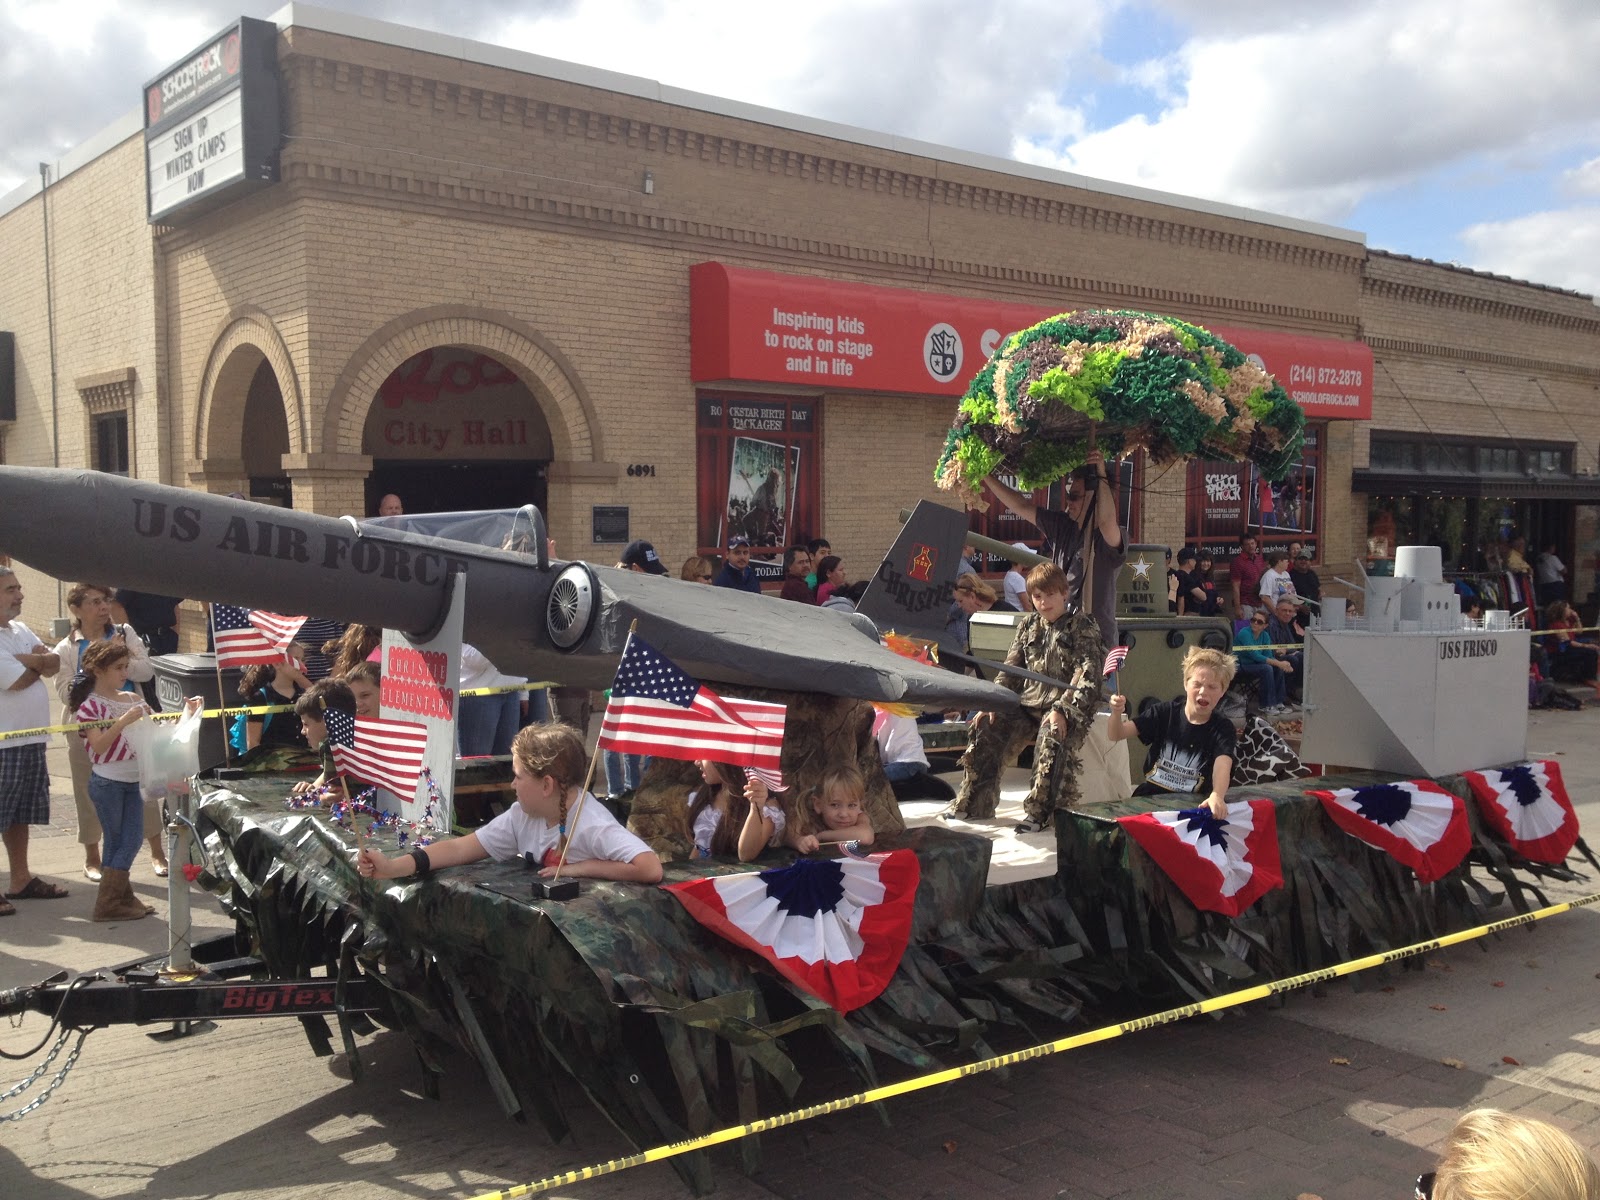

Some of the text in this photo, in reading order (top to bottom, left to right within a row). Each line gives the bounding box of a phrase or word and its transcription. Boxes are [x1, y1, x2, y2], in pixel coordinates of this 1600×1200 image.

[174, 116, 208, 152] SIGN UP
[166, 131, 226, 180] WINTER CAMPS
[187, 169, 205, 194] NOW
[773, 307, 865, 335] Inspiring kids
[765, 329, 873, 361] to rock on stage
[786, 356, 853, 377] and in life
[1290, 365, 1362, 387] (214) 872-2878
[1292, 391, 1360, 407] SCHOOLOFROCK.COM
[710, 405, 807, 421] ROCKSTAR BIRTHDAY
[384, 419, 528, 450] City Hall
[732, 418, 783, 431] PACKAGES!
[627, 463, 656, 477] 6891
[133, 498, 201, 543] US
[217, 516, 310, 565] AIR
[755, 567, 783, 577] TODAY!
[1132, 581, 1150, 591] US
[1120, 593, 1156, 605] ARMY
[1440, 639, 1498, 660] USS FRISCO
[389, 657, 446, 680] CHRISTIE
[160, 679, 181, 701] CWD
[382, 687, 452, 715] ELEMENTARY
